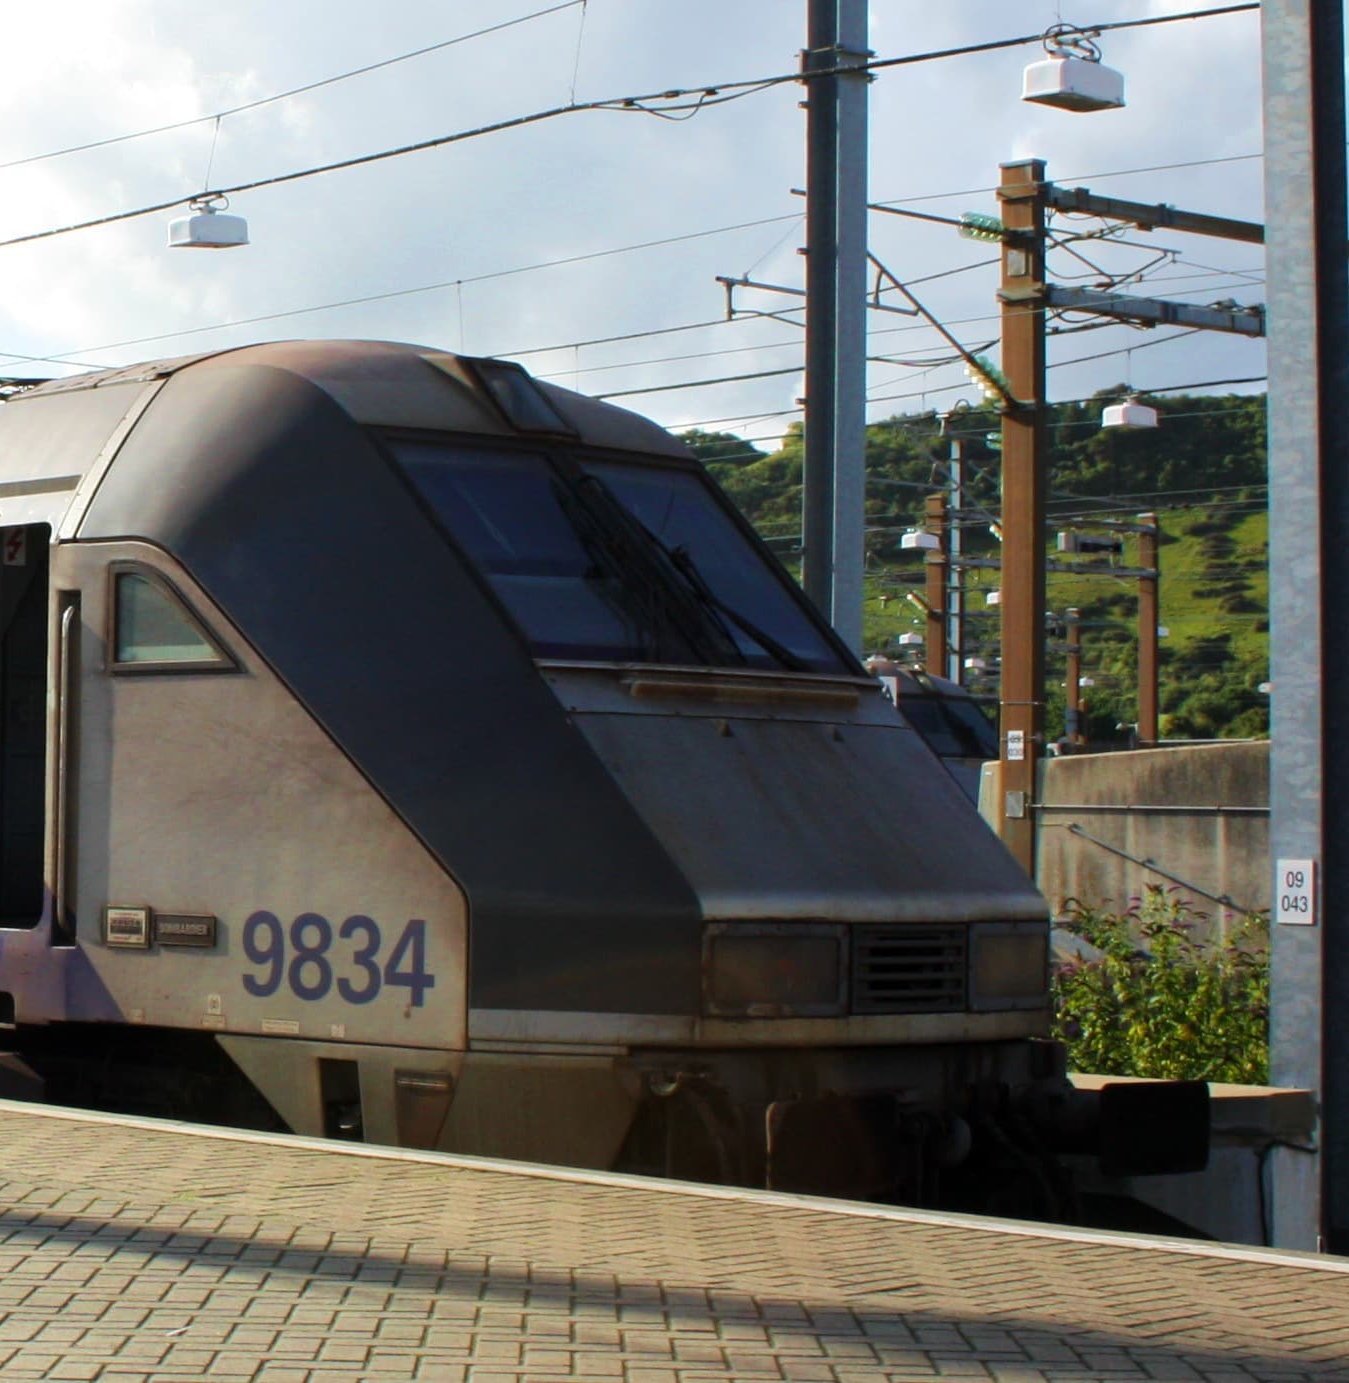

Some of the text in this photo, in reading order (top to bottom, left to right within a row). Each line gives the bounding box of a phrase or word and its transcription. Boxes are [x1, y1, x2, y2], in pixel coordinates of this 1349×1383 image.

[1286, 871, 1304, 888] 09
[1282, 895, 1308, 912] 043
[242, 910, 435, 1007] 9834
